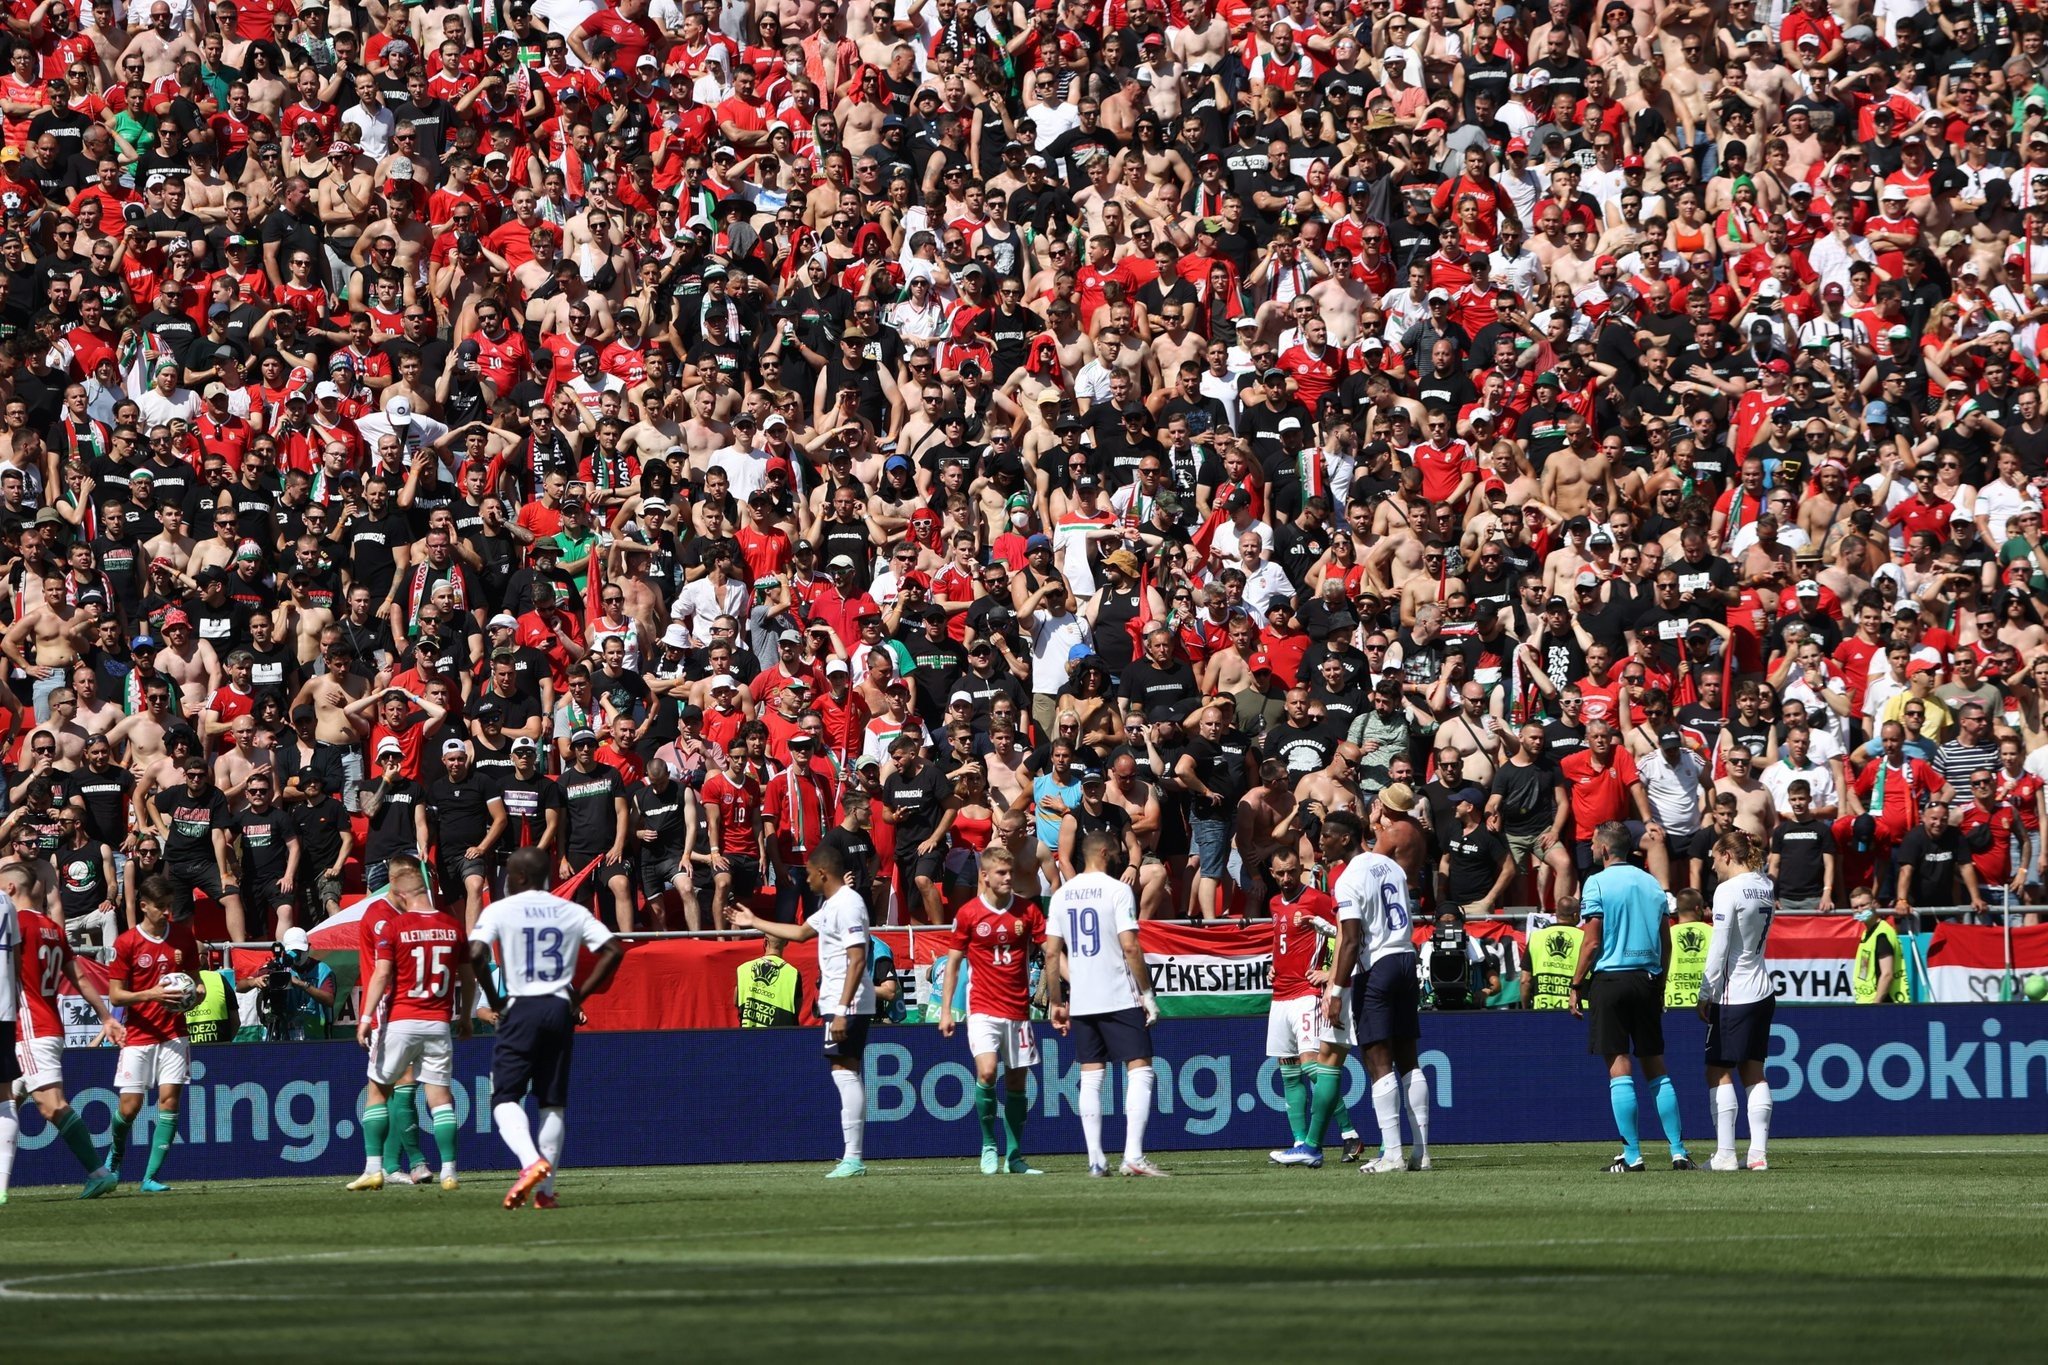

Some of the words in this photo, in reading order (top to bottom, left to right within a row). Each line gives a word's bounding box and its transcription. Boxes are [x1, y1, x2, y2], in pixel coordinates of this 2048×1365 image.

[1231, 156, 1266, 168] addas
[488, 357, 502, 369] 10
[1279, 739, 1326, 756] MAGYARORSZÁG
[81, 784, 121, 793] MAGYARORSZÁG
[733, 807, 746, 823] 10
[1065, 888, 1101, 900] BENZEMA
[1380, 883, 1407, 931] 6
[398, 930, 456, 943] KLEINHEISLER
[1067, 907, 1101, 957] 19
[1756, 906, 1773, 955] 7
[525, 927, 567, 982] 13
[1279, 934, 1286, 955] 5
[992, 944, 1012, 966] 13
[38, 945, 63, 997] 20
[409, 945, 451, 998] 15
[1771, 963, 1854, 997] GYHÁ
[1302, 1013, 1311, 1032] 5
[1705, 1023, 1713, 1043] 7
